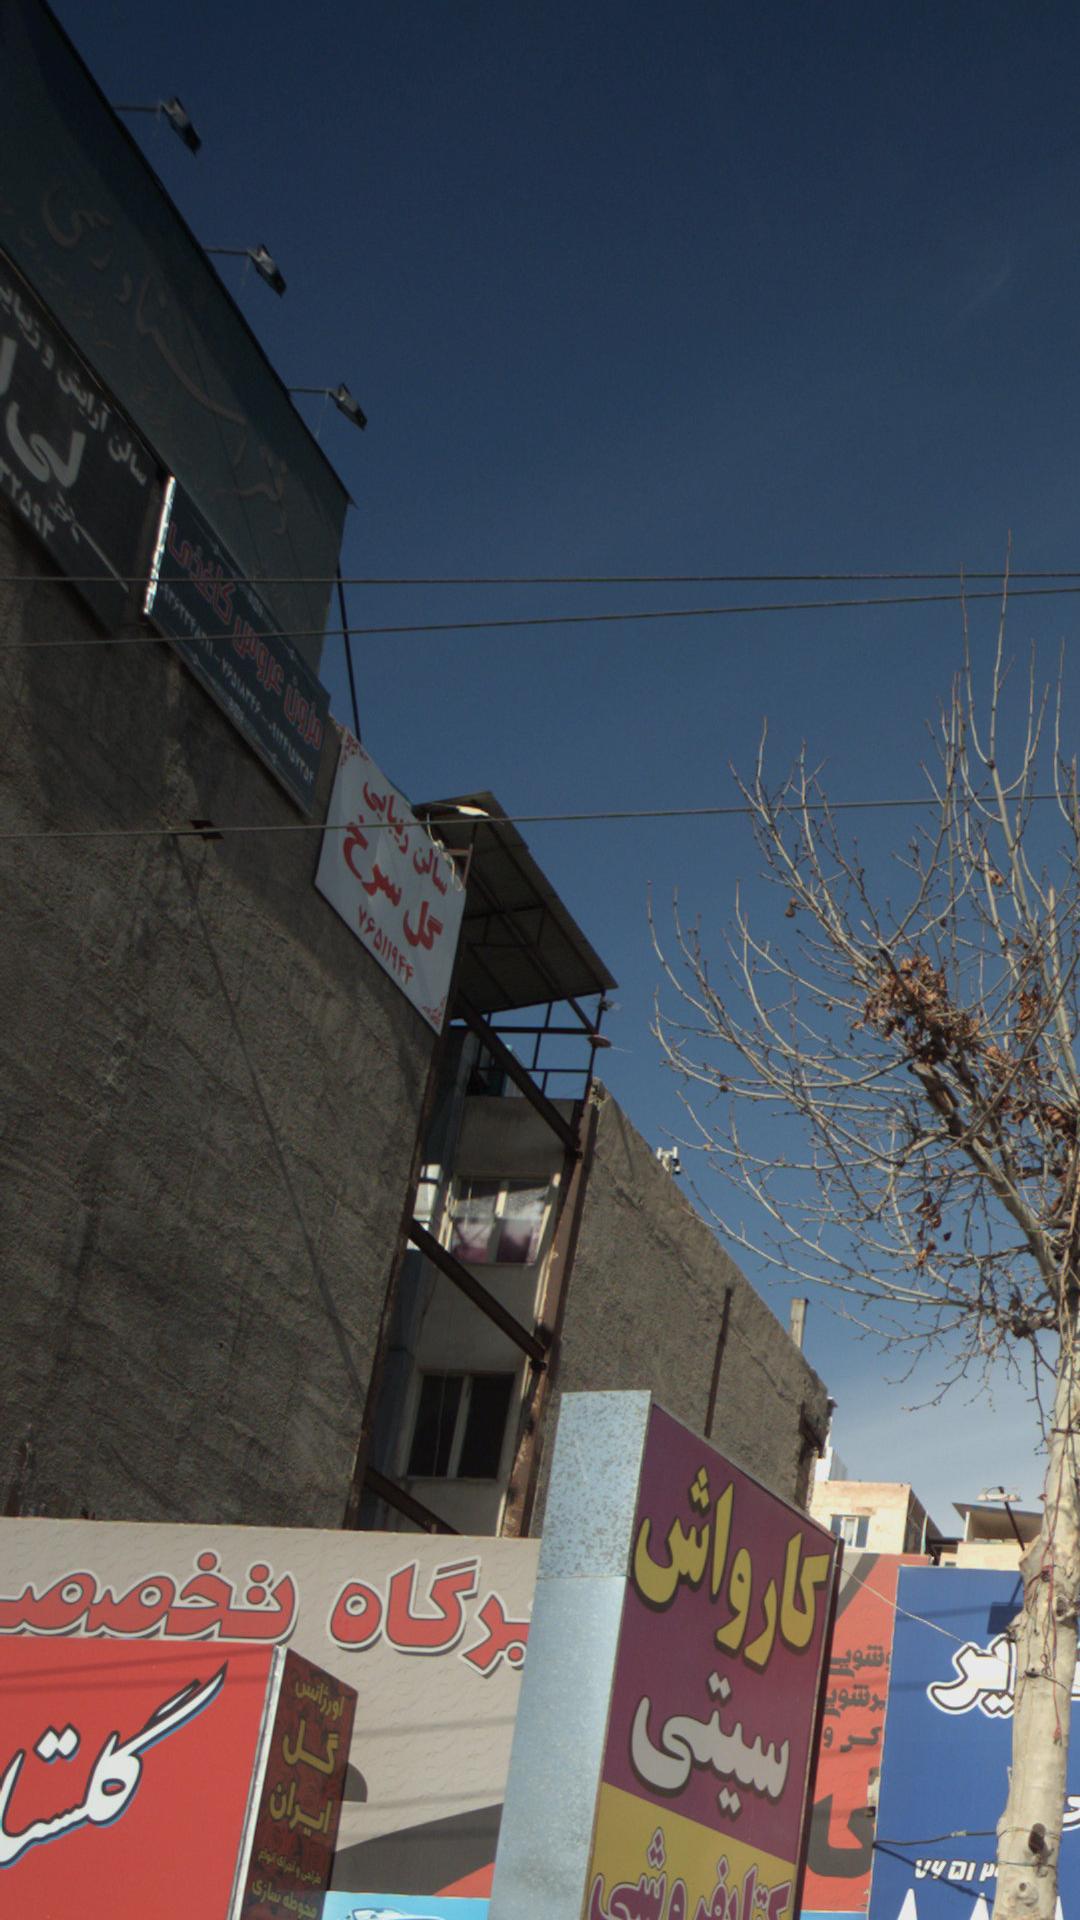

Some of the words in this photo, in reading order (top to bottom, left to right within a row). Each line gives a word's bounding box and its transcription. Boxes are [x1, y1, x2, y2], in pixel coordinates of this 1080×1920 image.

[342, 815, 402, 907] سرخ
[413, 846, 448, 896] سالن
[403, 901, 443, 950] گل
[0, 1551, 300, 1645] تخصص
[633, 1466, 830, 1666] کارواش
[283, 1719, 339, 1775] گل
[631, 1672, 790, 1815] سیتی
[270, 1782, 333, 1837] ایران
